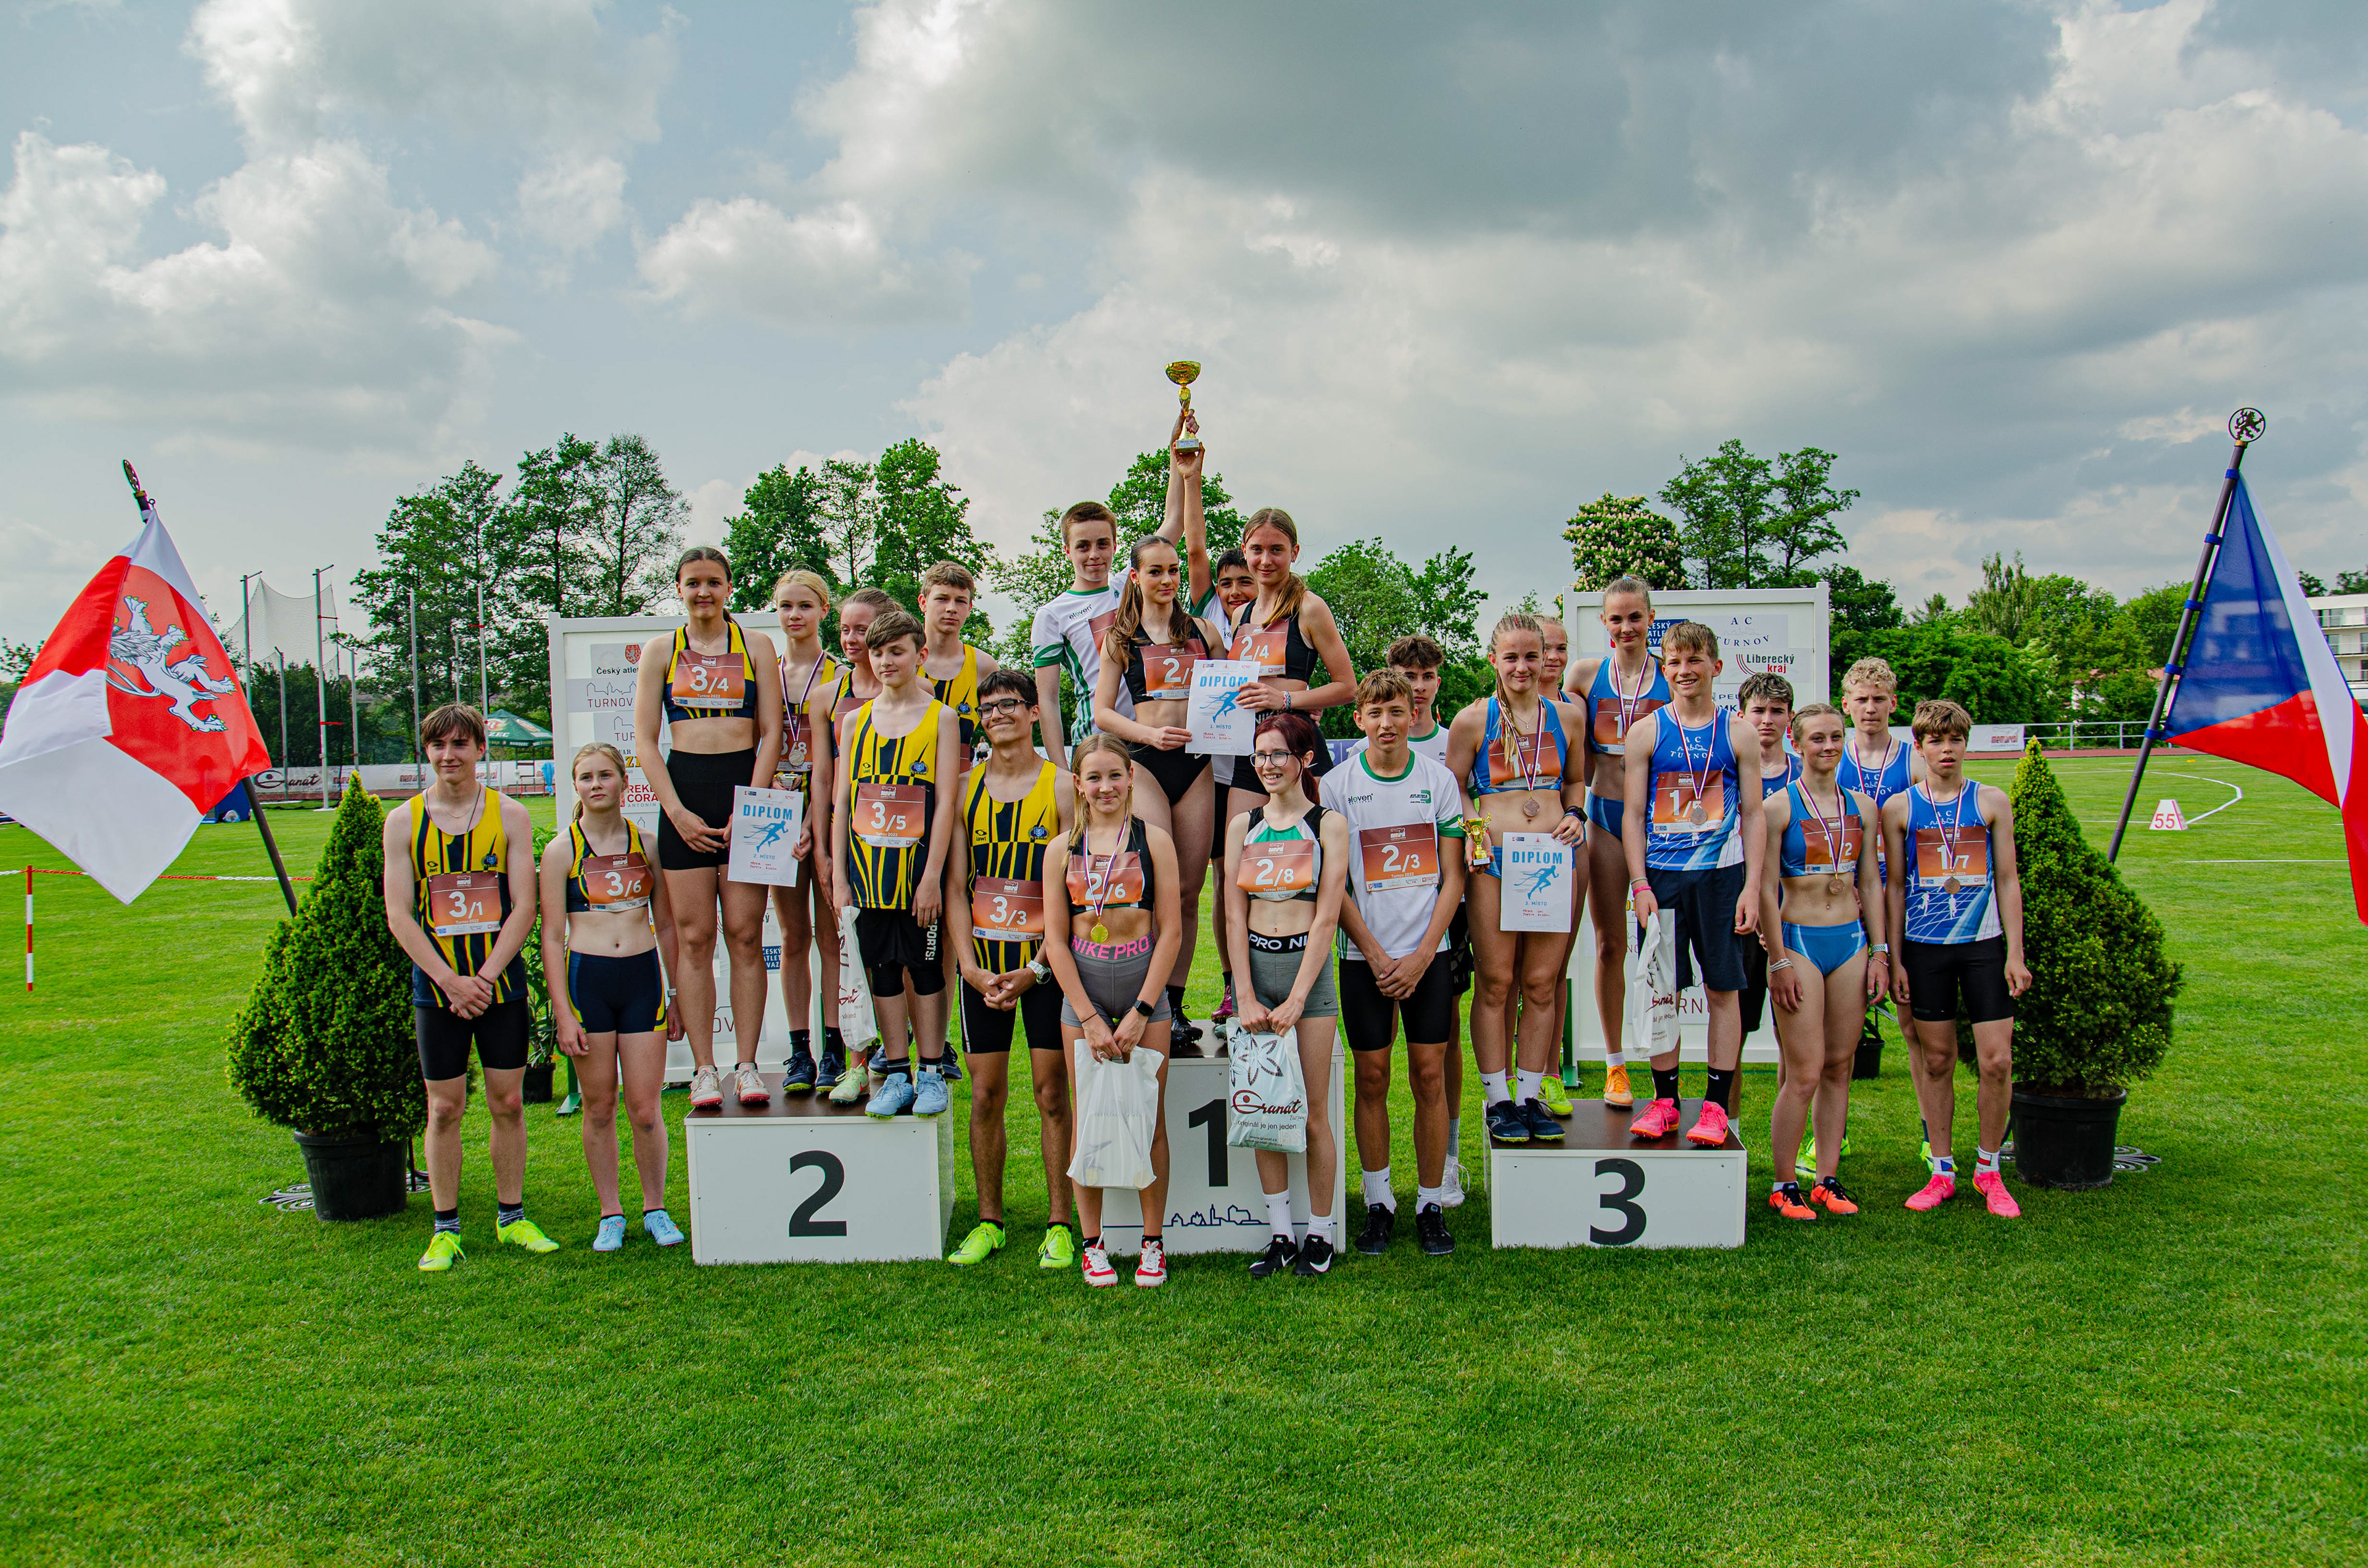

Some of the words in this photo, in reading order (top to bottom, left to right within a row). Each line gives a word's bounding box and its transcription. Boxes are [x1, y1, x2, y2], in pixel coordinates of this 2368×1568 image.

[596, 666, 620, 675] Český
[1746, 654, 1794, 665] Liberecký
[1767, 664, 1786, 673] kraj
[690, 666, 729, 694] 3/4
[1199, 676, 1248, 688] DIPLOM
[587, 698, 633, 707] TURNOV
[743, 805, 793, 821] DIPLOM
[871, 802, 906, 831] 3/5
[2155, 813, 2174, 829] 55
[1381, 845, 1420, 872] 2/3
[1512, 852, 1562, 864] DIPLOM
[605, 872, 641, 897] 3/6
[1256, 859, 1294, 887] 2/8
[449, 891, 483, 919] 3/1
[990, 896, 1027, 926] 3/3
[925, 919, 937, 960] PORTS!
[1071, 935, 1111, 959] NIKE
[1114, 936, 1149, 960] PRO
[1249, 934, 1282, 950] PRO
[1231, 1090, 1303, 1114] Granát
[1188, 1099, 1228, 1188] 1
[789, 1150, 847, 1237] 2
[1590, 1159, 1648, 1246] 3
